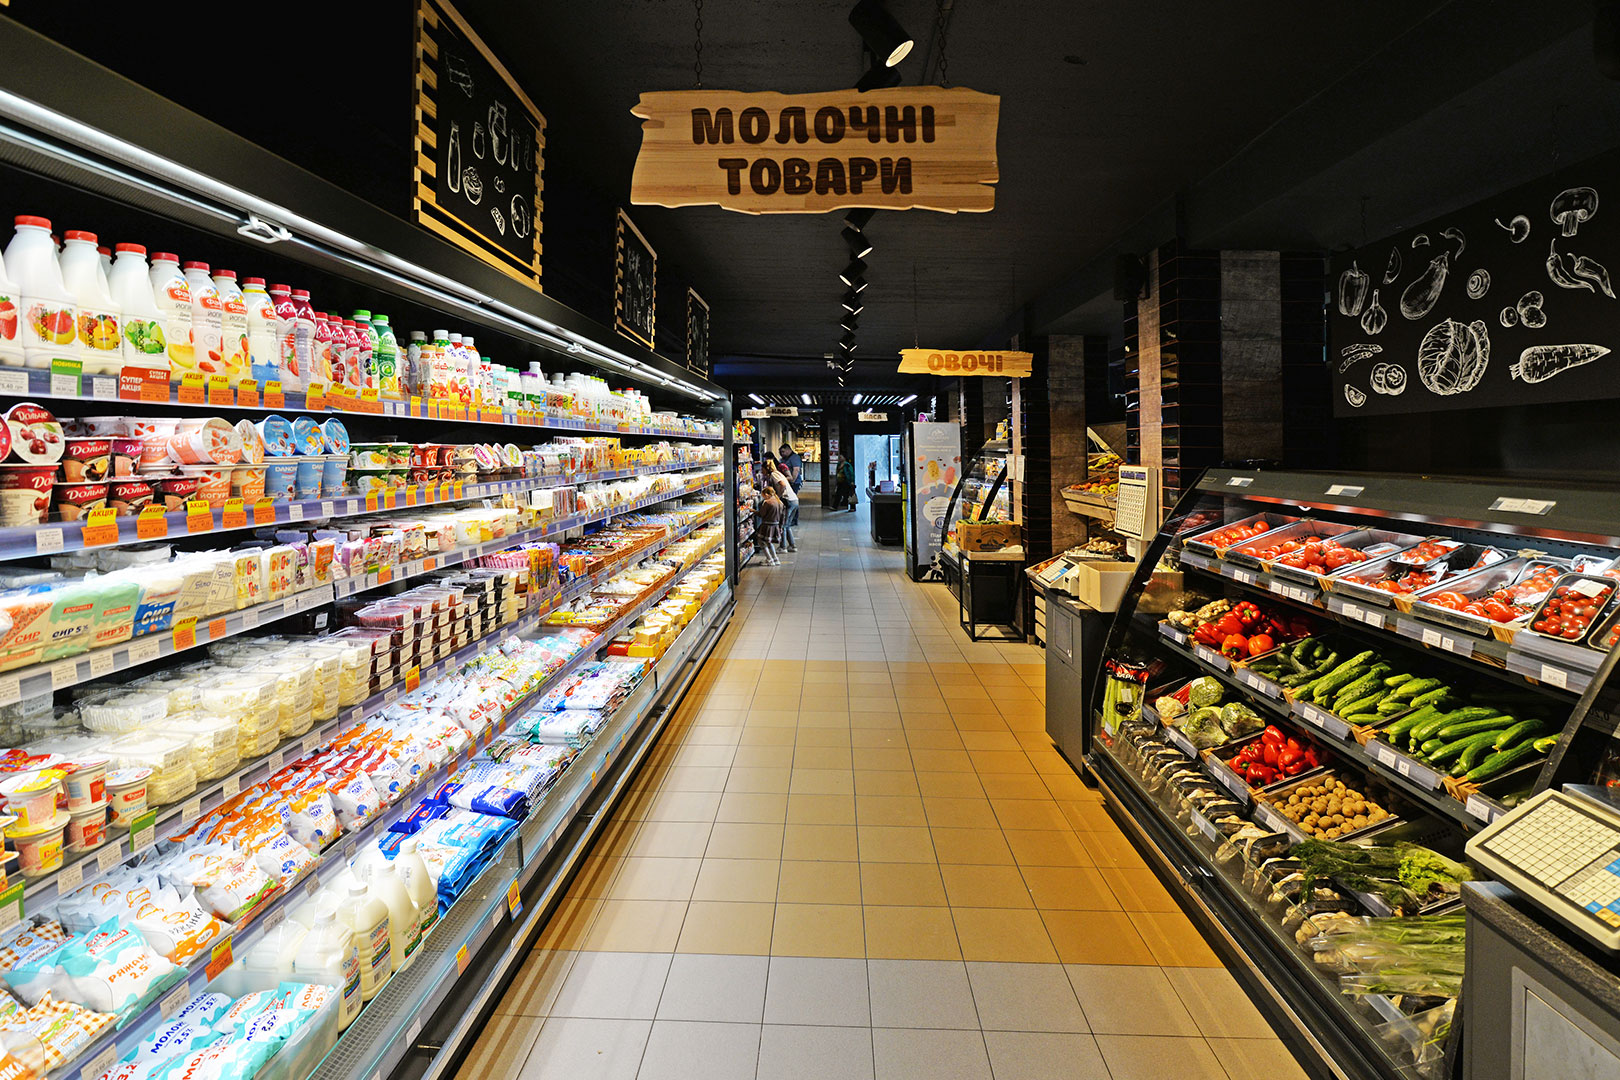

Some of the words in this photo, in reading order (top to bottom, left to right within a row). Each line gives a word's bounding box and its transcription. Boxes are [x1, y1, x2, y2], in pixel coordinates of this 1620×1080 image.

[691, 105, 936, 145] МОЛОЧНІ
[718, 156, 914, 196] ТОВАРИ
[52, 360, 82, 370] НОВИНКА
[927, 353, 1003, 373] ОВОЧІ
[120, 375, 144, 385] СУПЕР
[211, 376, 228, 384] АКЦІЯ
[70, 445, 108, 455] Дольче
[66, 487, 106, 500] Дольче
[91, 509, 114, 518] АКЦІЯ
[141, 606, 171, 625] СИР
[15, 631, 41, 643] СИР
[52, 628, 74, 639] СИР
